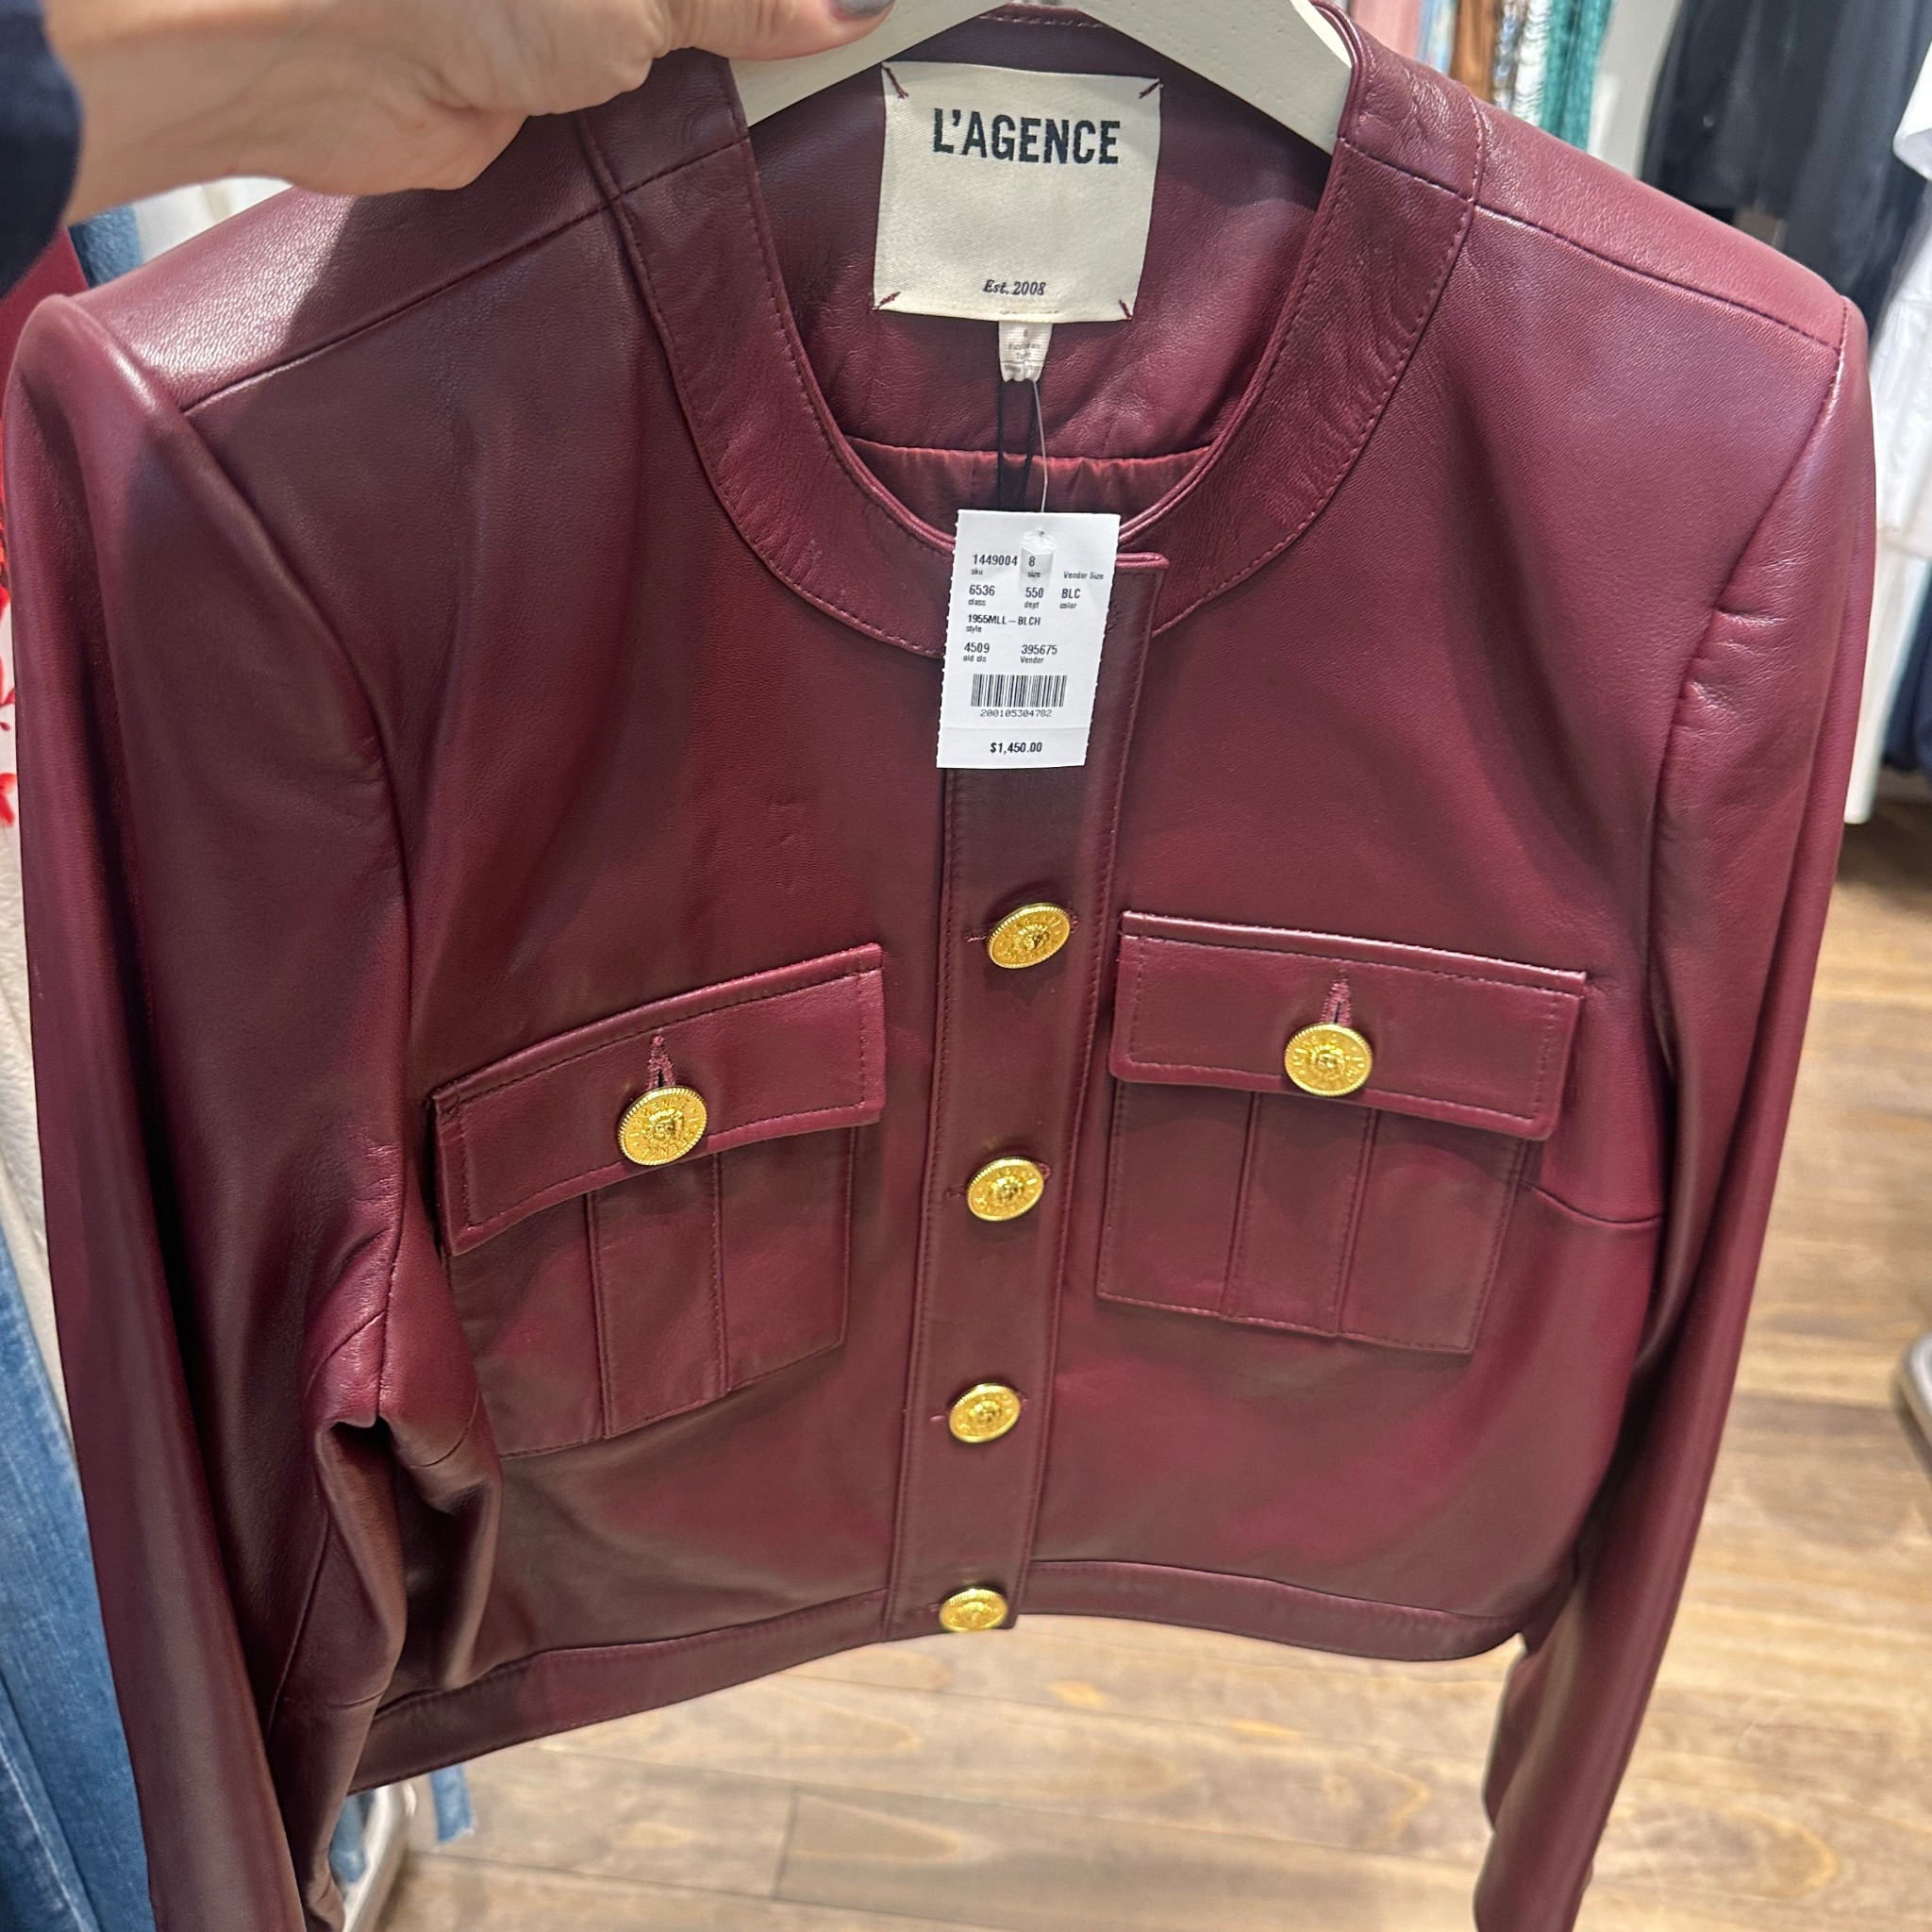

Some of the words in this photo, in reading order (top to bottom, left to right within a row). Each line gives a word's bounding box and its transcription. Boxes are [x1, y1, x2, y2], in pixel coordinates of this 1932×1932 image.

[933, 108, 1121, 164] L'AGENCE
[982, 280, 1008, 294] Est.
[1012, 281, 1046, 295] 2008
[973, 554, 1018, 566] 1449004
[1028, 556, 1036, 567] 8
[1063, 571, 1087, 579] Vendor
[1090, 572, 1104, 580] Size
[969, 585, 995, 596] 6536
[1025, 587, 1043, 598] 550
[1061, 589, 1080, 599] BLC
[968, 598, 986, 607] class
[1024, 601, 1040, 609] dept
[964, 642, 990, 653] 4509
[1021, 644, 1058, 655] 395675
[1020, 656, 1044, 664] Vendor
[990, 742, 1042, 755] $1,450.00
